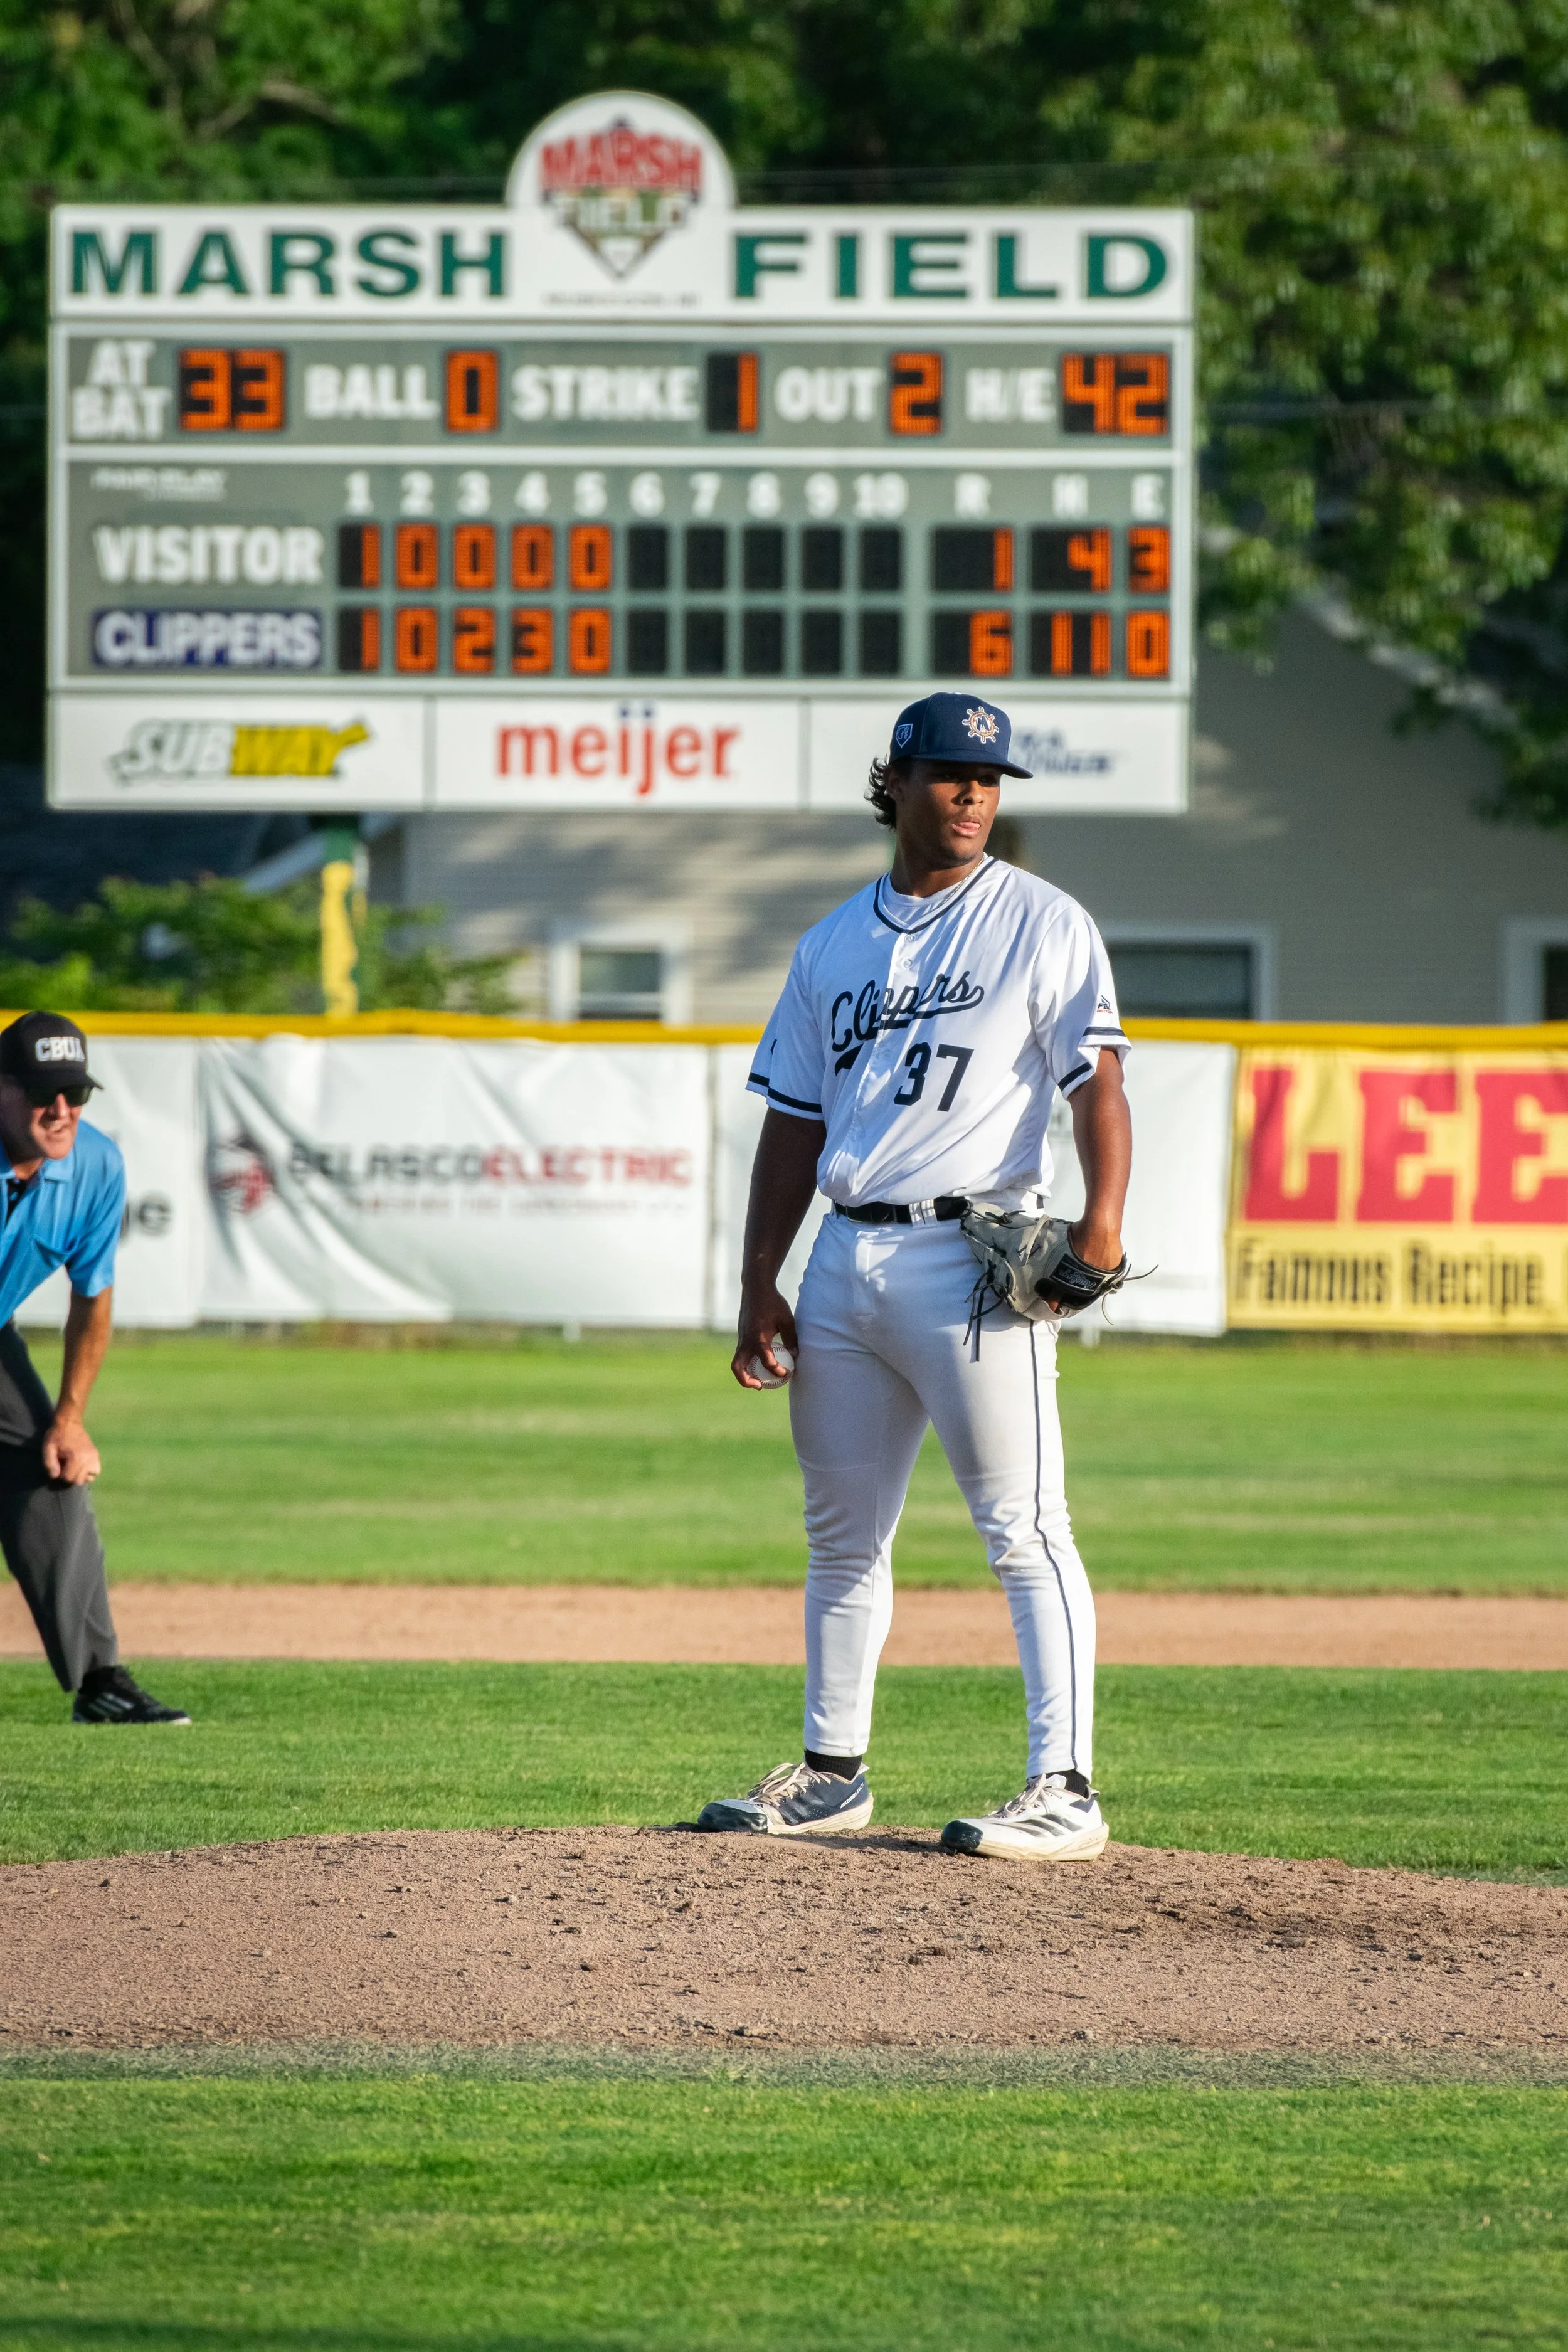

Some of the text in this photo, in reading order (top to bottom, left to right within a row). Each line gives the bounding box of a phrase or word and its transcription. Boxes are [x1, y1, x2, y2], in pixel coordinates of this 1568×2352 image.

[541, 129, 704, 195] MARSH
[70, 229, 1169, 299] MARSH FIELD
[87, 340, 155, 385] AT
[179, 349, 285, 432] 33
[302, 365, 438, 420] BALL
[445, 349, 499, 433] 0
[512, 366, 700, 421] STRIKE
[737, 352, 758, 433] 1
[775, 367, 881, 421] OUT
[889, 352, 942, 435] 2
[966, 367, 1056, 422] H/E
[1062, 353, 1168, 435] 42
[72, 386, 169, 440] BAT
[345, 471, 1165, 518] 1 2 3 4 5 6 7 8 9 10 R H E
[93, 524, 324, 585] VISITOR
[361, 524, 1170, 593] 1 0 0 0 0 1 4 3
[95, 610, 321, 666] CLIPPERS
[361, 607, 1170, 677] 1 0 2 3 0 6 11 0
[109, 718, 369, 781] SUBWAY
[499, 706, 741, 795] meijer
[894, 1042, 974, 1113] 37
[1244, 1067, 1568, 1224] LEE
[1236, 1238, 1544, 1317] Famous Recipe
